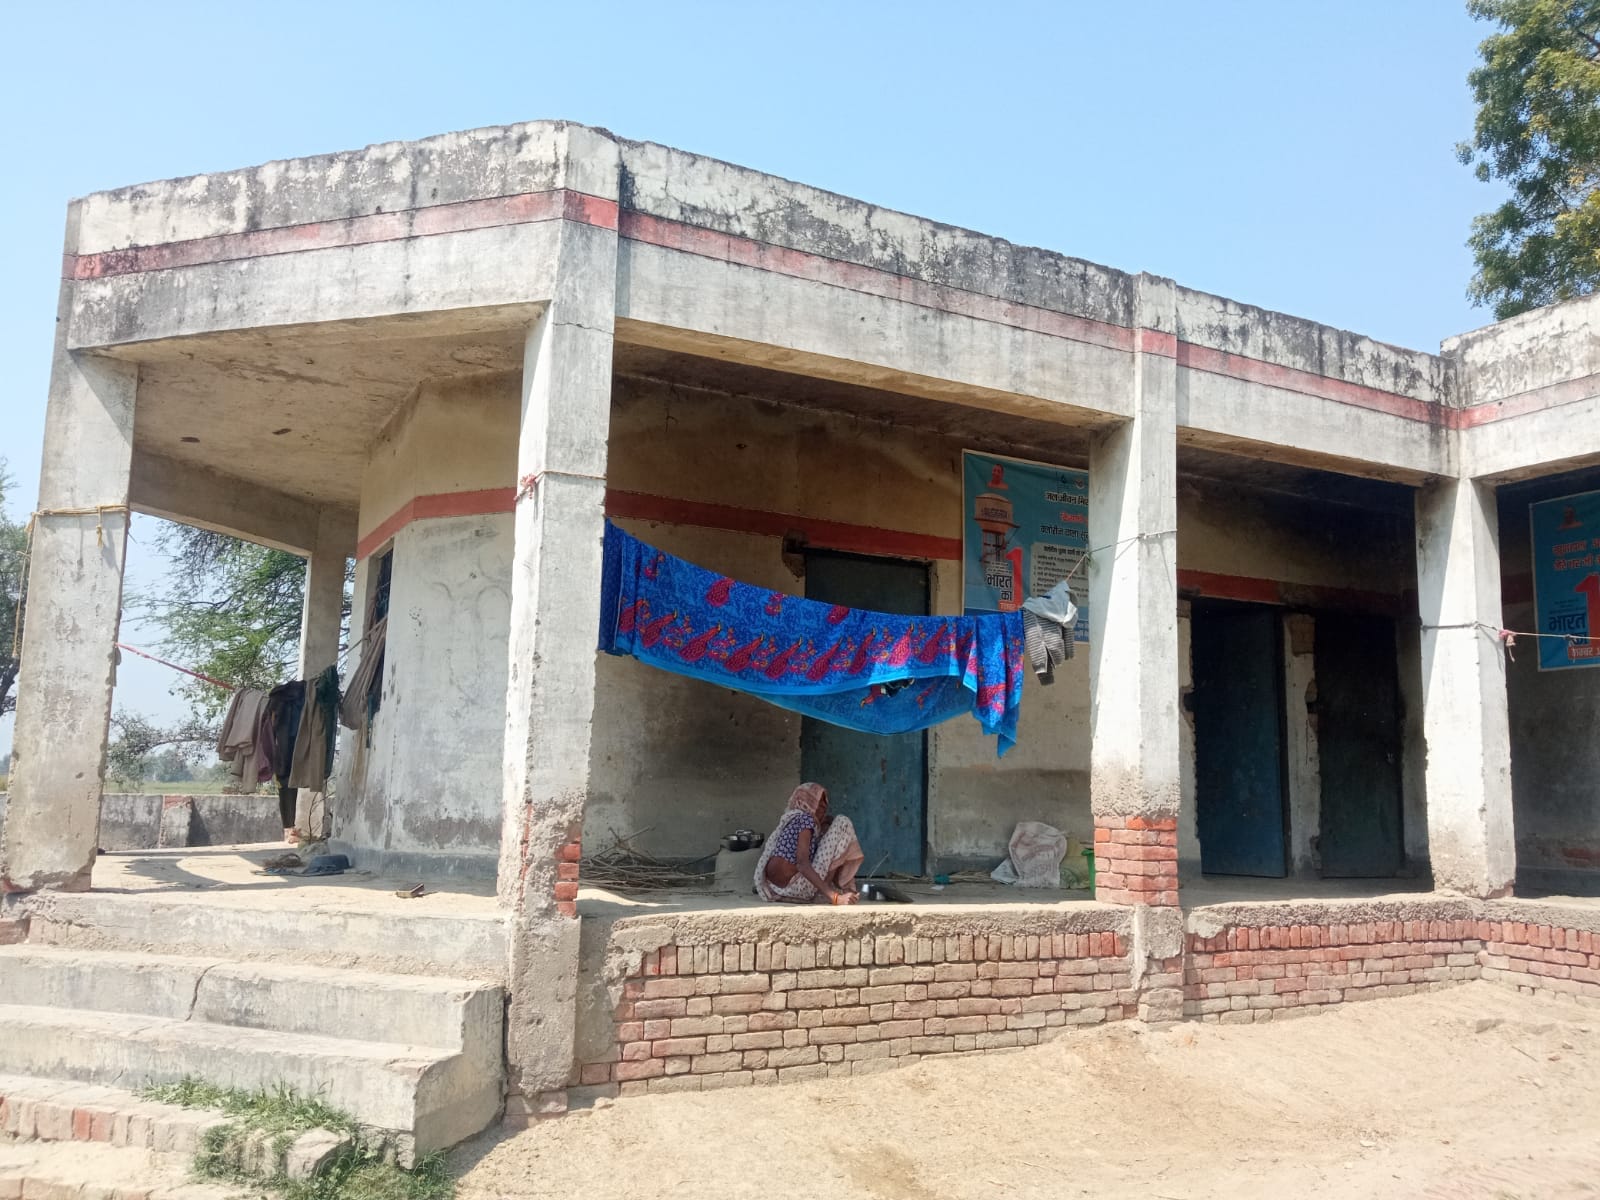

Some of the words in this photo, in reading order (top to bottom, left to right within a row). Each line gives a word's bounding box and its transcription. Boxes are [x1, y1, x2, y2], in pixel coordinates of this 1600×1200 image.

[987, 573, 1012, 588] भारत
[1000, 590, 1013, 601] का
[1549, 613, 1586, 631] भारत
